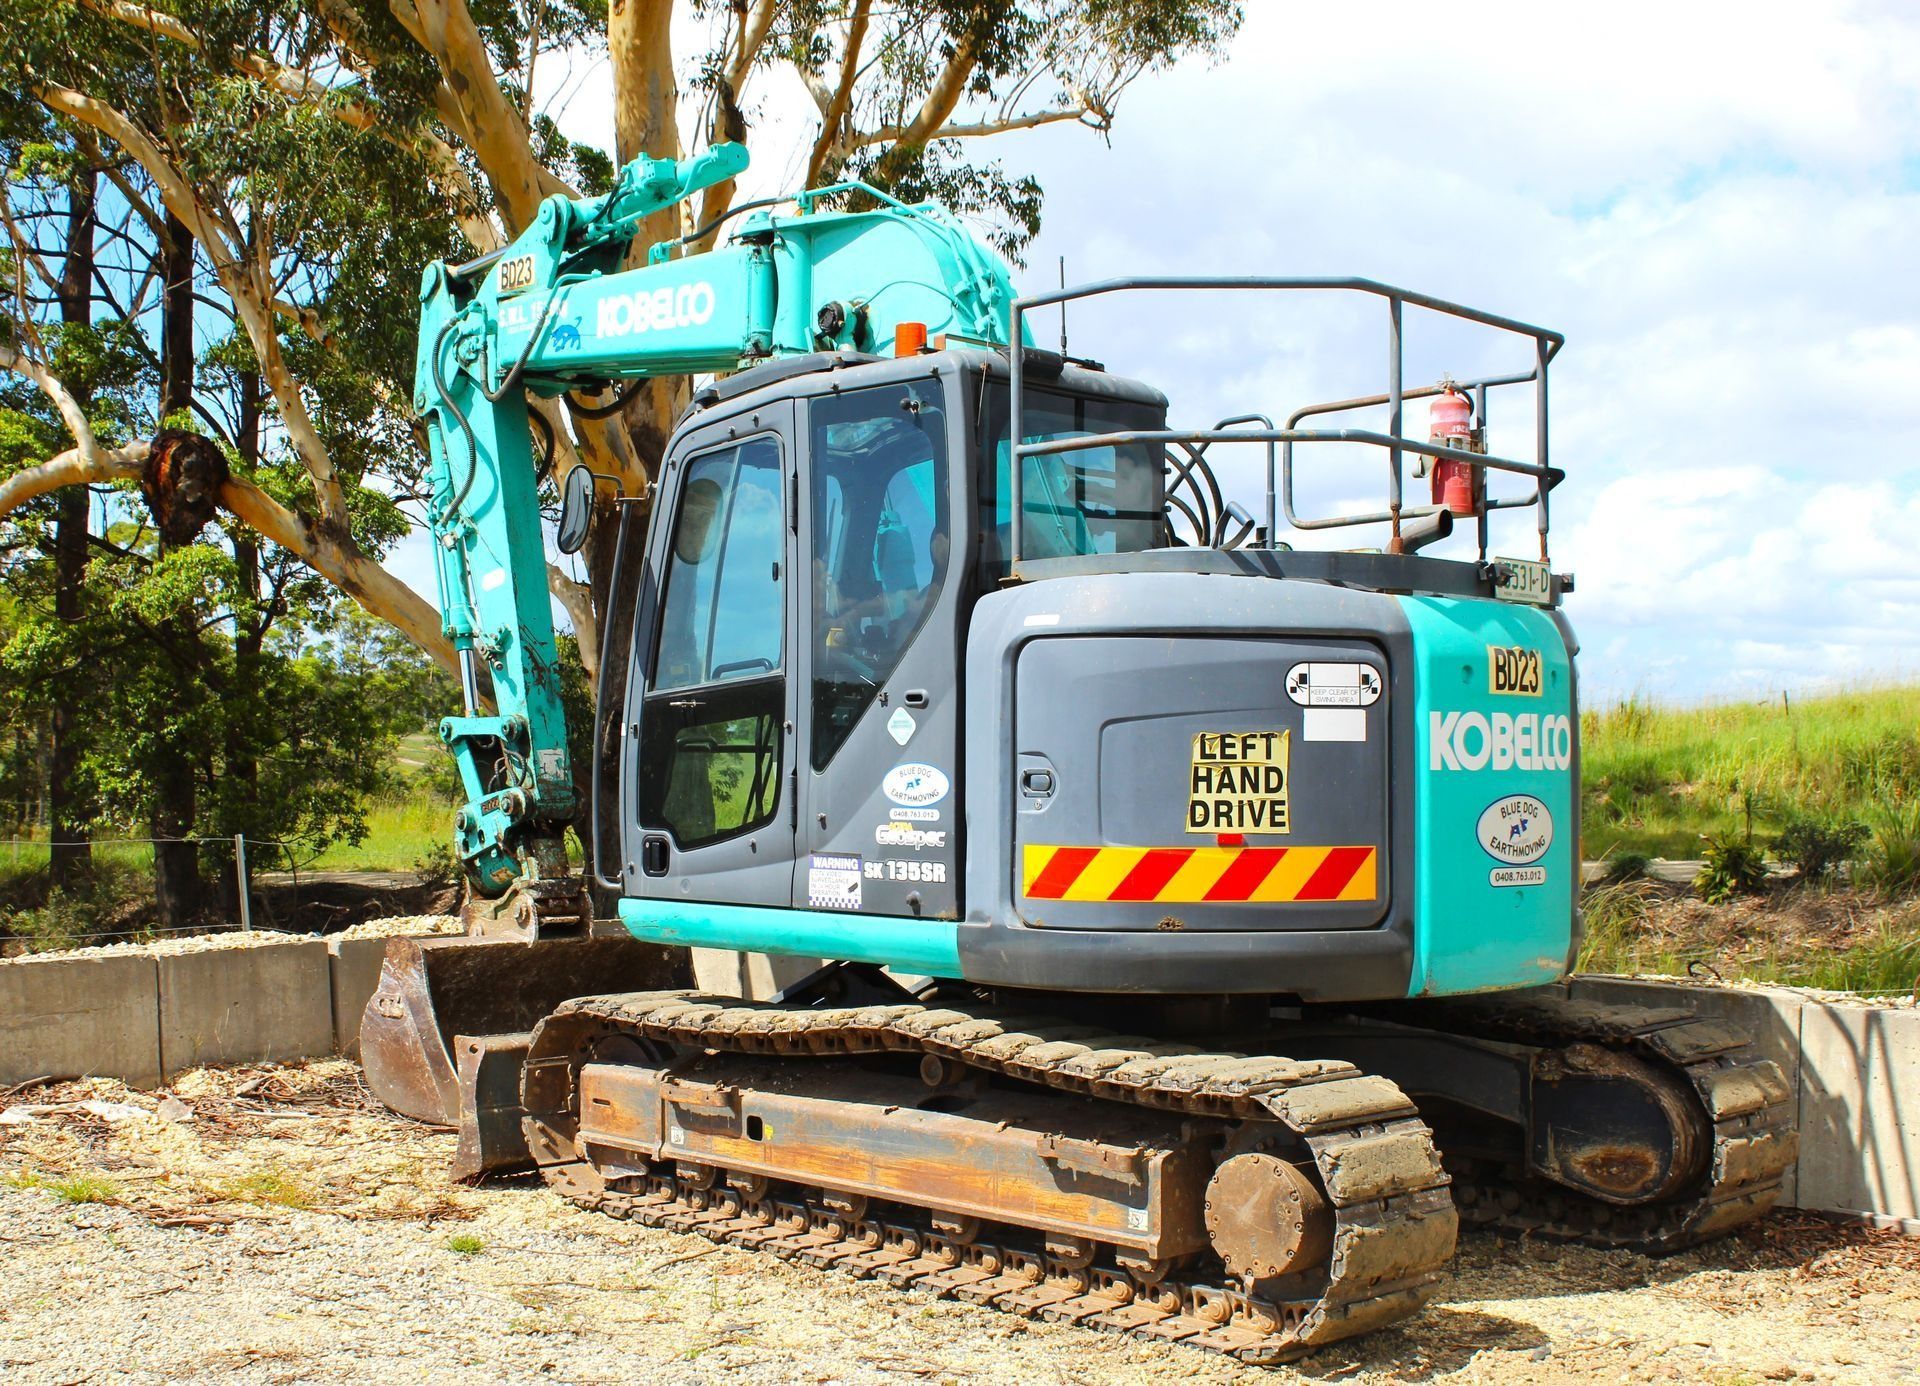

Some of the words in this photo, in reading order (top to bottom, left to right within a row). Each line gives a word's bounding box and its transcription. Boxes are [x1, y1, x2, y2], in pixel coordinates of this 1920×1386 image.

[501, 257, 532, 290] BD23
[596, 280, 716, 339] KOBELCO
[1494, 648, 1539, 693] BD23
[1200, 733, 1278, 760] LEFT
[1429, 711, 1571, 771] KOBELCO
[899, 766, 916, 777] BLUE
[918, 767, 932, 778] DOG
[1192, 766, 1284, 793] HAND
[890, 788, 940, 802] EARTHMOVING
[893, 810, 935, 819] 0408.763.012
[1190, 800, 1286, 828] DRIVE
[1500, 801, 1521, 819] BLUE
[1523, 801, 1539, 818] DOG
[1489, 835, 1546, 857] EARTHMOVING
[813, 856, 859, 870] WARNING
[863, 861, 884, 880] SK
[885, 860, 947, 883] 135SR
[1494, 870, 1542, 883] 0408.763.012
